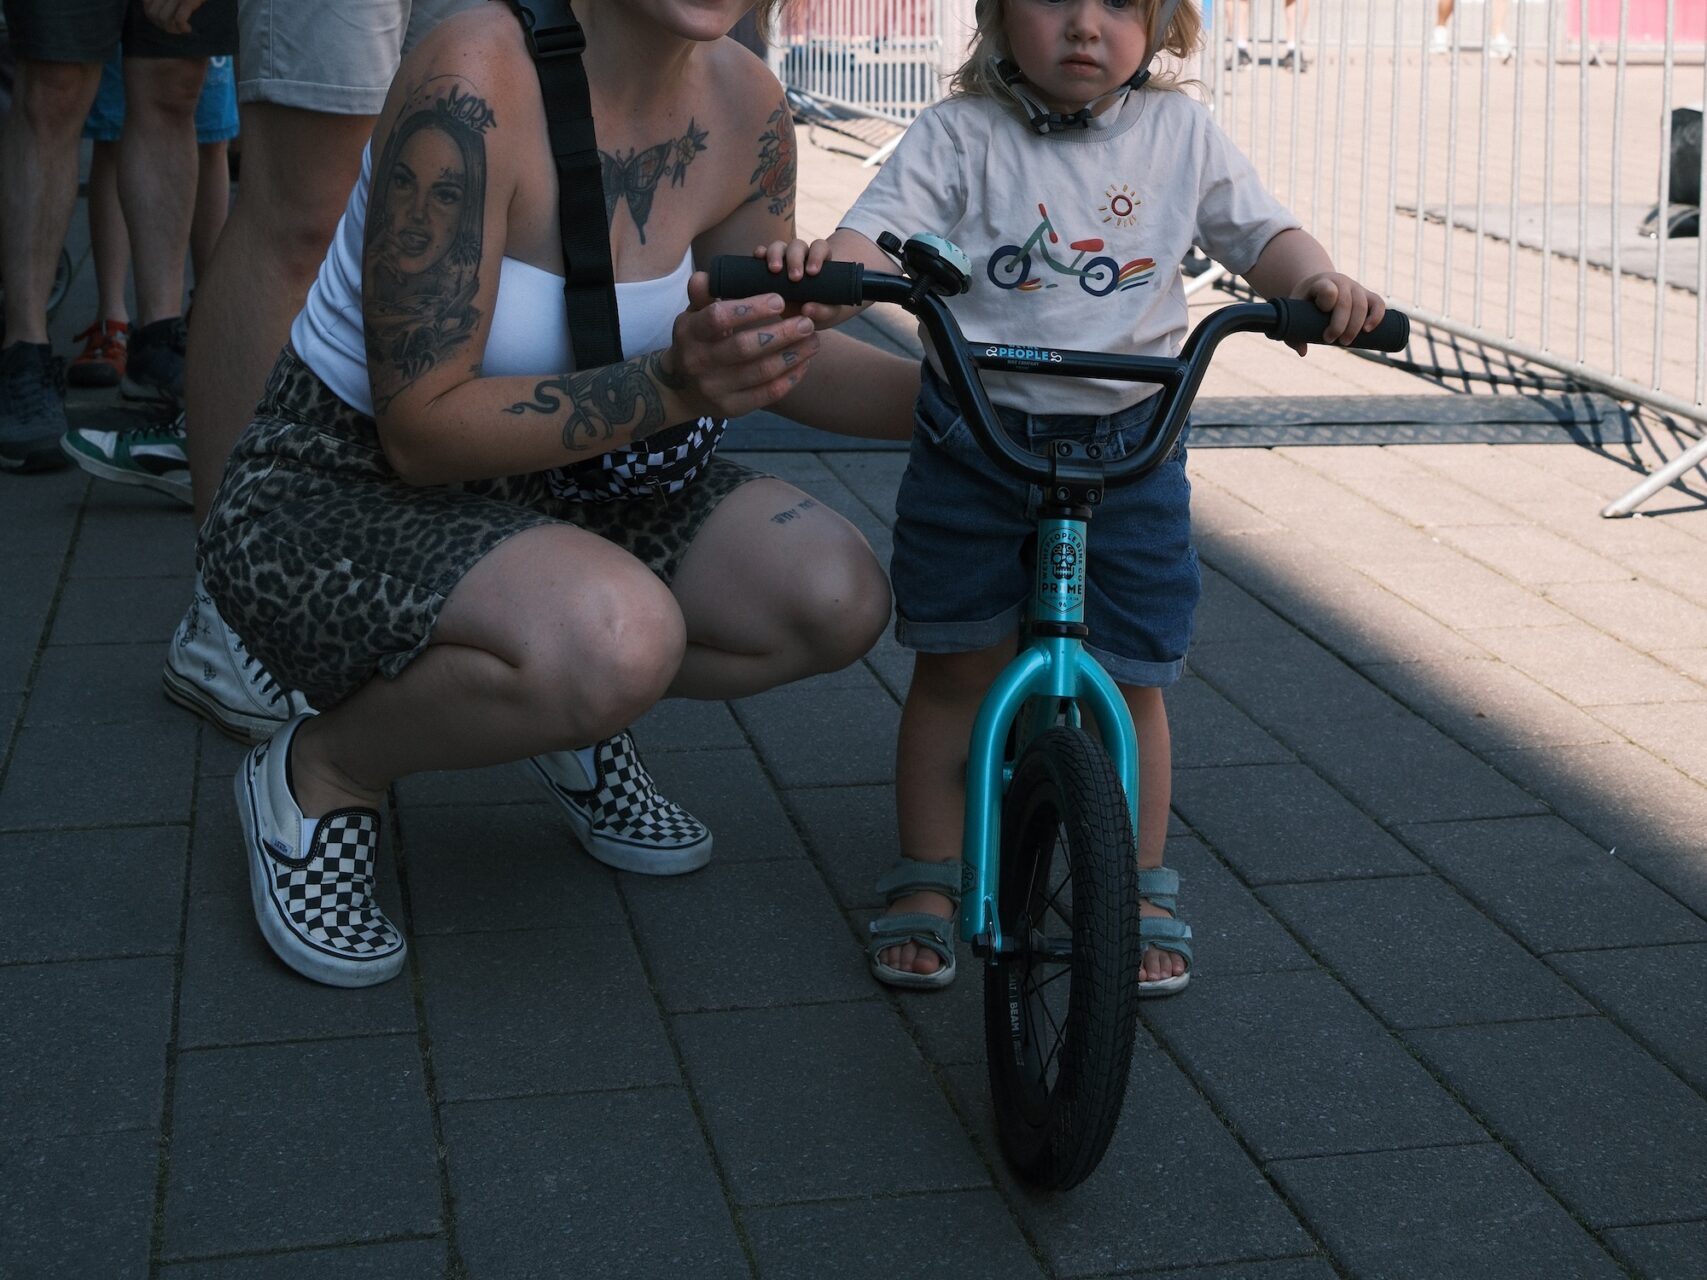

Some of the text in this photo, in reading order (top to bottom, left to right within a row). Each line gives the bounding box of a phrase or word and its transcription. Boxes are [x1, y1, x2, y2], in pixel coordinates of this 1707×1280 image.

[999, 347, 1049, 361] PEOPLE
[1042, 582, 1082, 595] PRIME
[1009, 1001, 1020, 1032] BEAM
